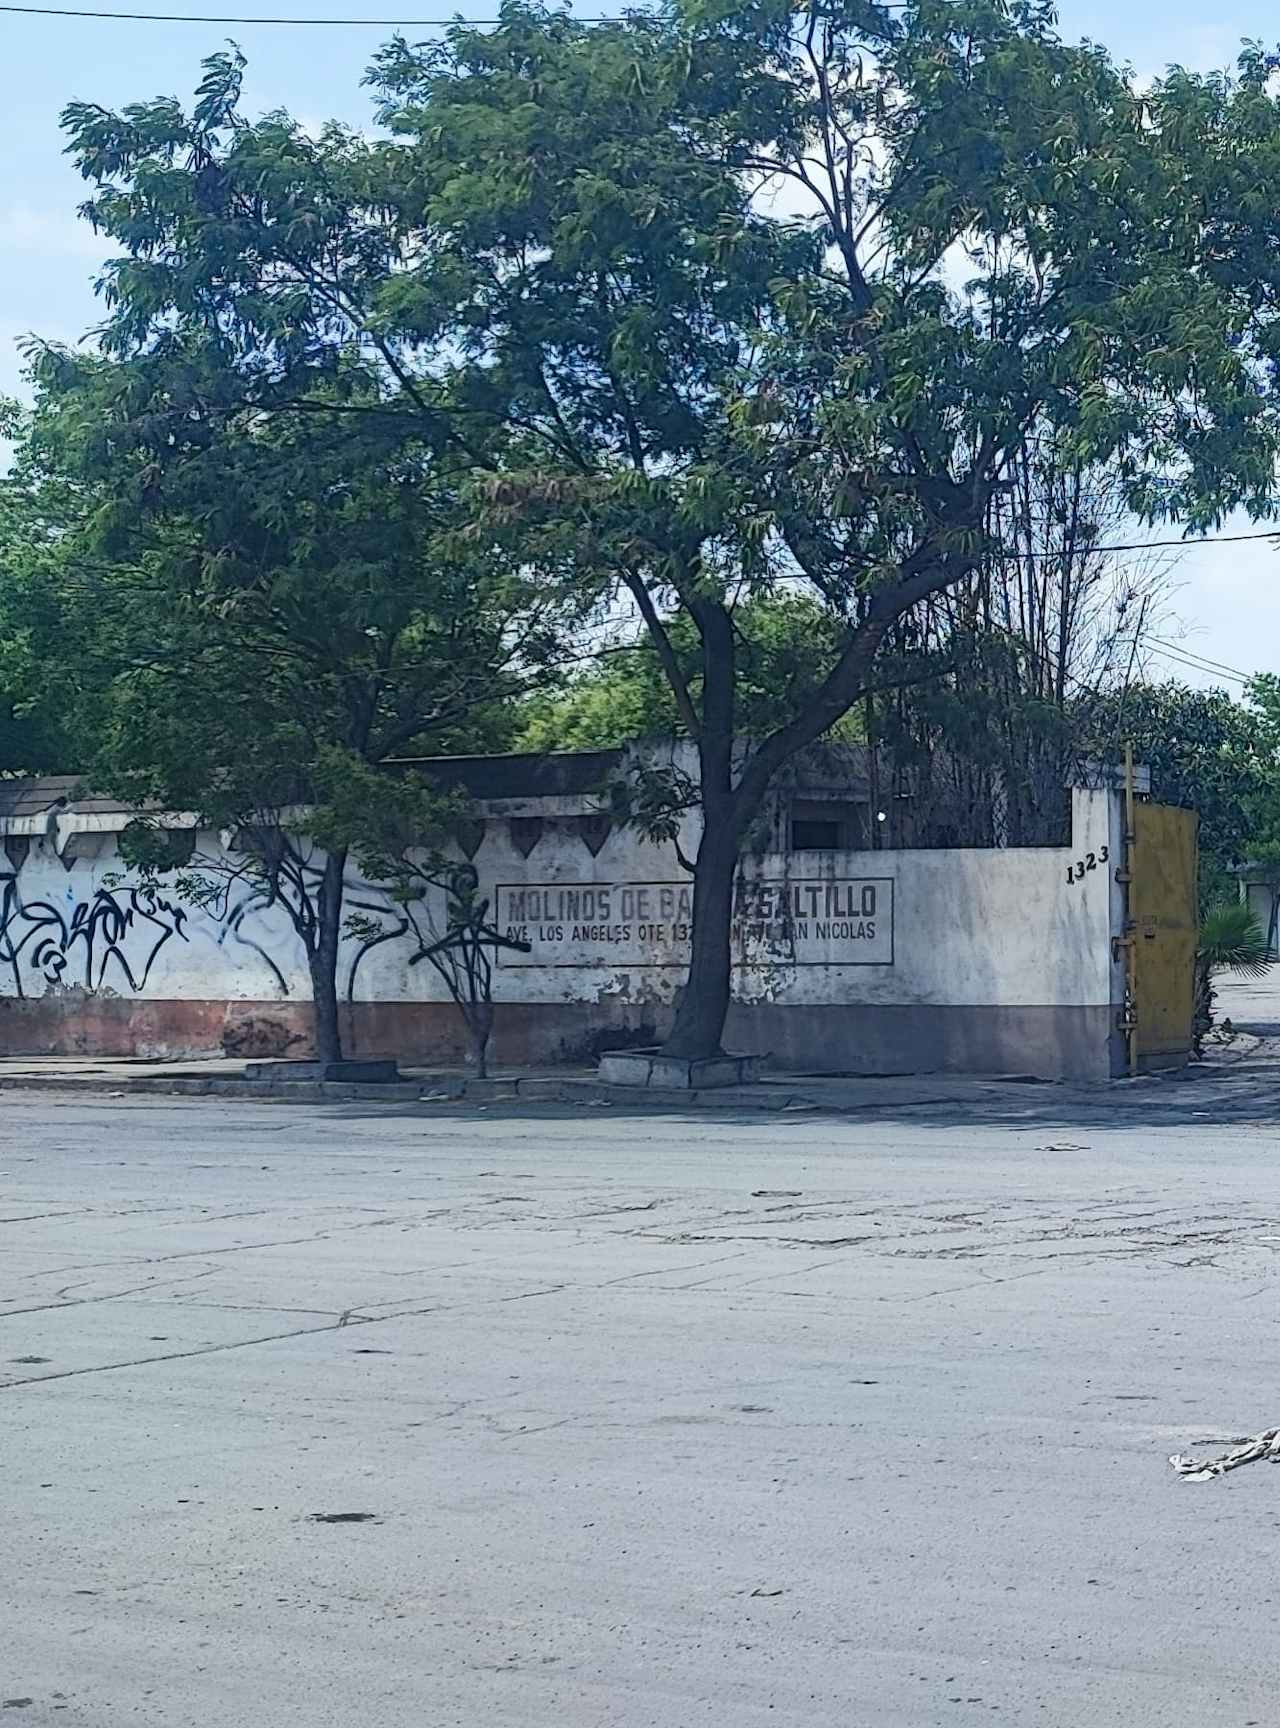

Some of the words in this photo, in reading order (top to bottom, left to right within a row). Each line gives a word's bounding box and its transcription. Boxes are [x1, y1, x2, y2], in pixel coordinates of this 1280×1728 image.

[1065, 845, 1109, 885] 1323
[508, 889, 610, 922] MOLINOS
[620, 889, 650, 921] DE
[660, 887, 692, 921] BA
[506, 926, 533, 943] AVE.
[539, 926, 564, 942] LOS
[571, 925, 631, 943] ANGELES
[638, 924, 665, 942] OTE
[672, 924, 694, 942] 13
[815, 921, 876, 940] NICOLAS
